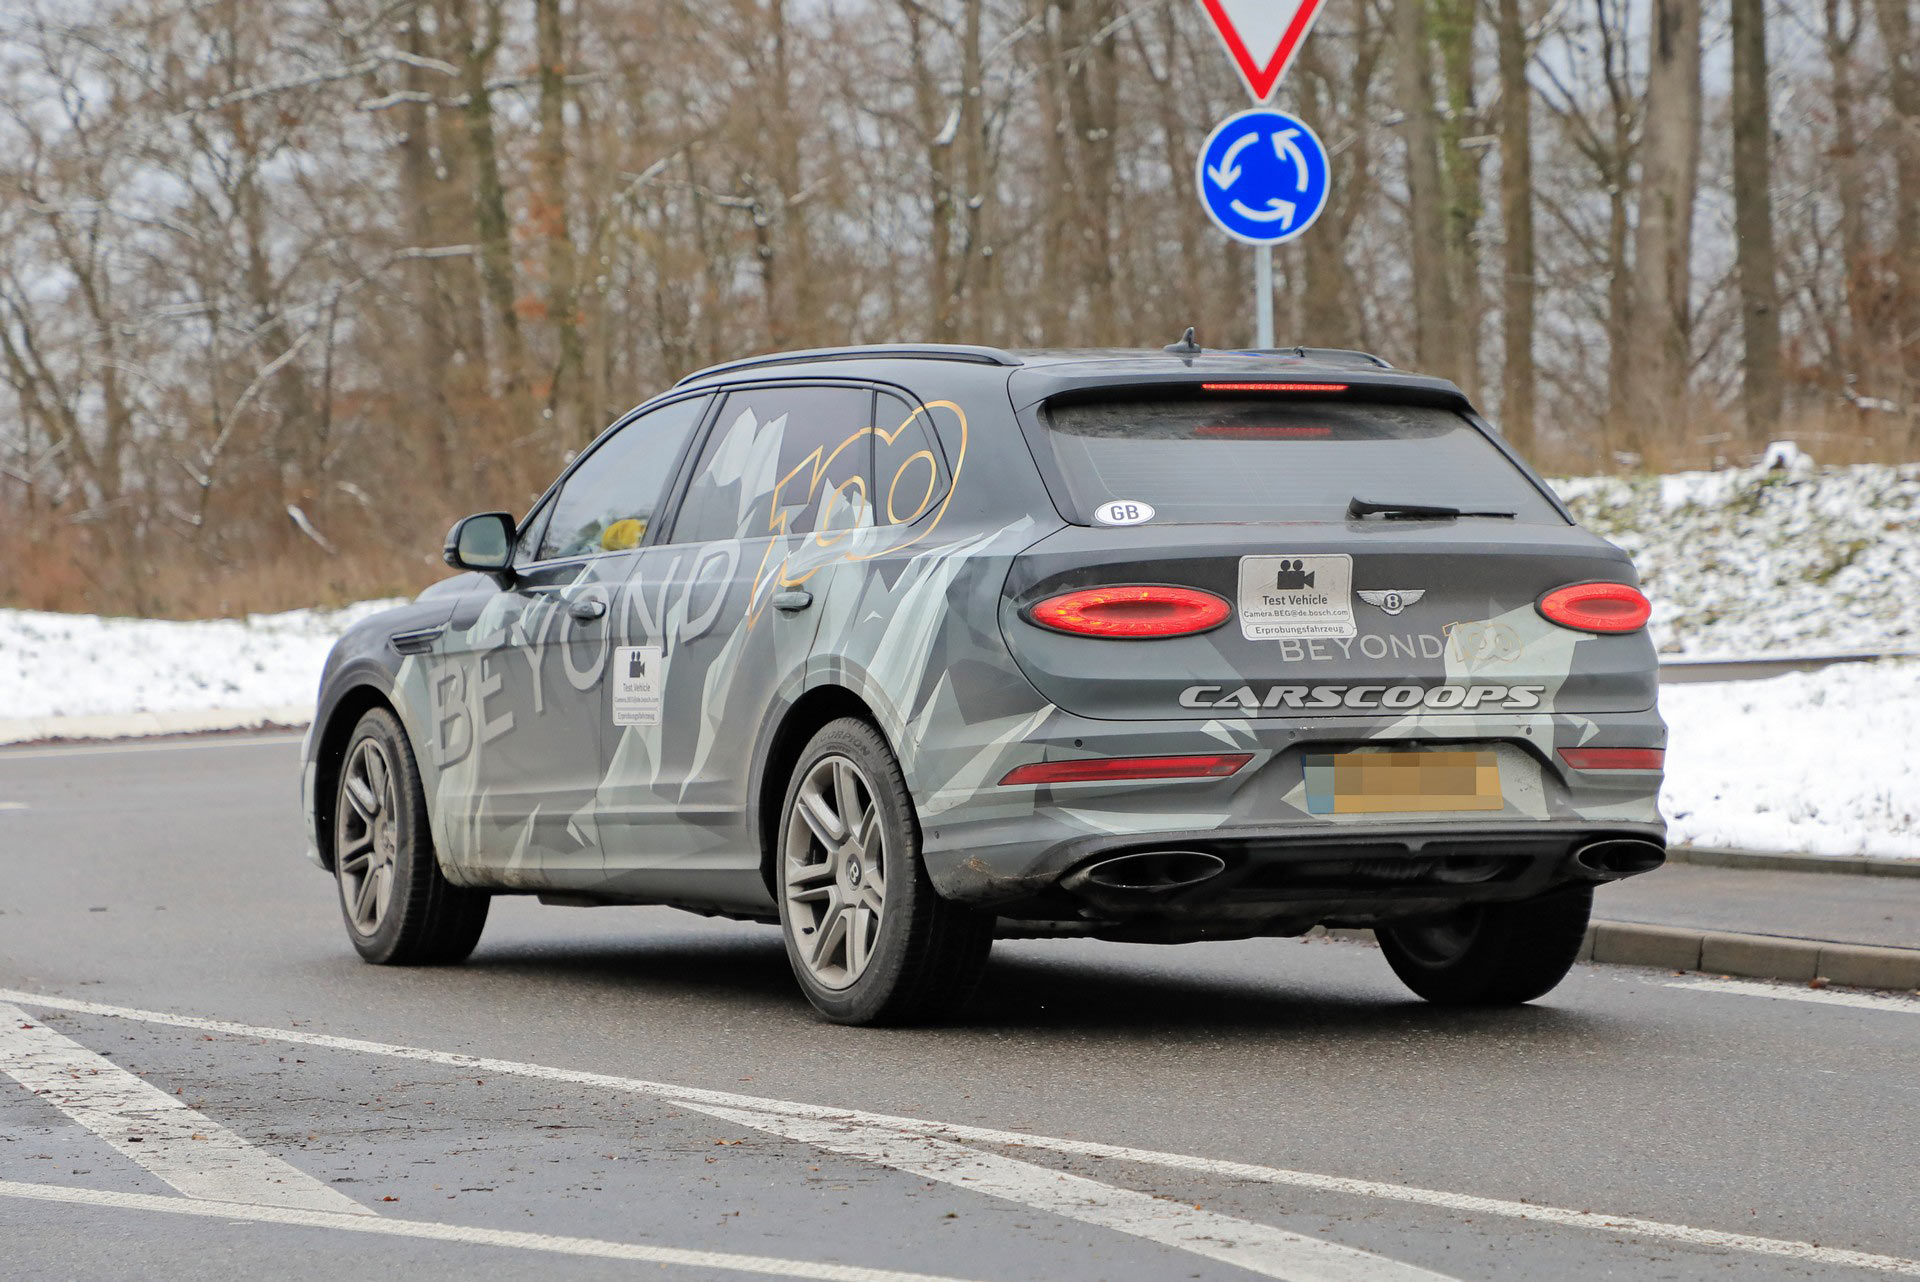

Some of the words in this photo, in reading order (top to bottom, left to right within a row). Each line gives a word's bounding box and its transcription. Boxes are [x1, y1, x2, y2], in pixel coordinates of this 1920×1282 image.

[1110, 504, 1140, 521] GB
[1262, 595, 1286, 606] Test
[1288, 593, 1328, 606] Vehicle
[1243, 608, 1349, 618] Camera.BEG@de.bosch.com
[1255, 625, 1345, 635] Erprobungsfahrzeug
